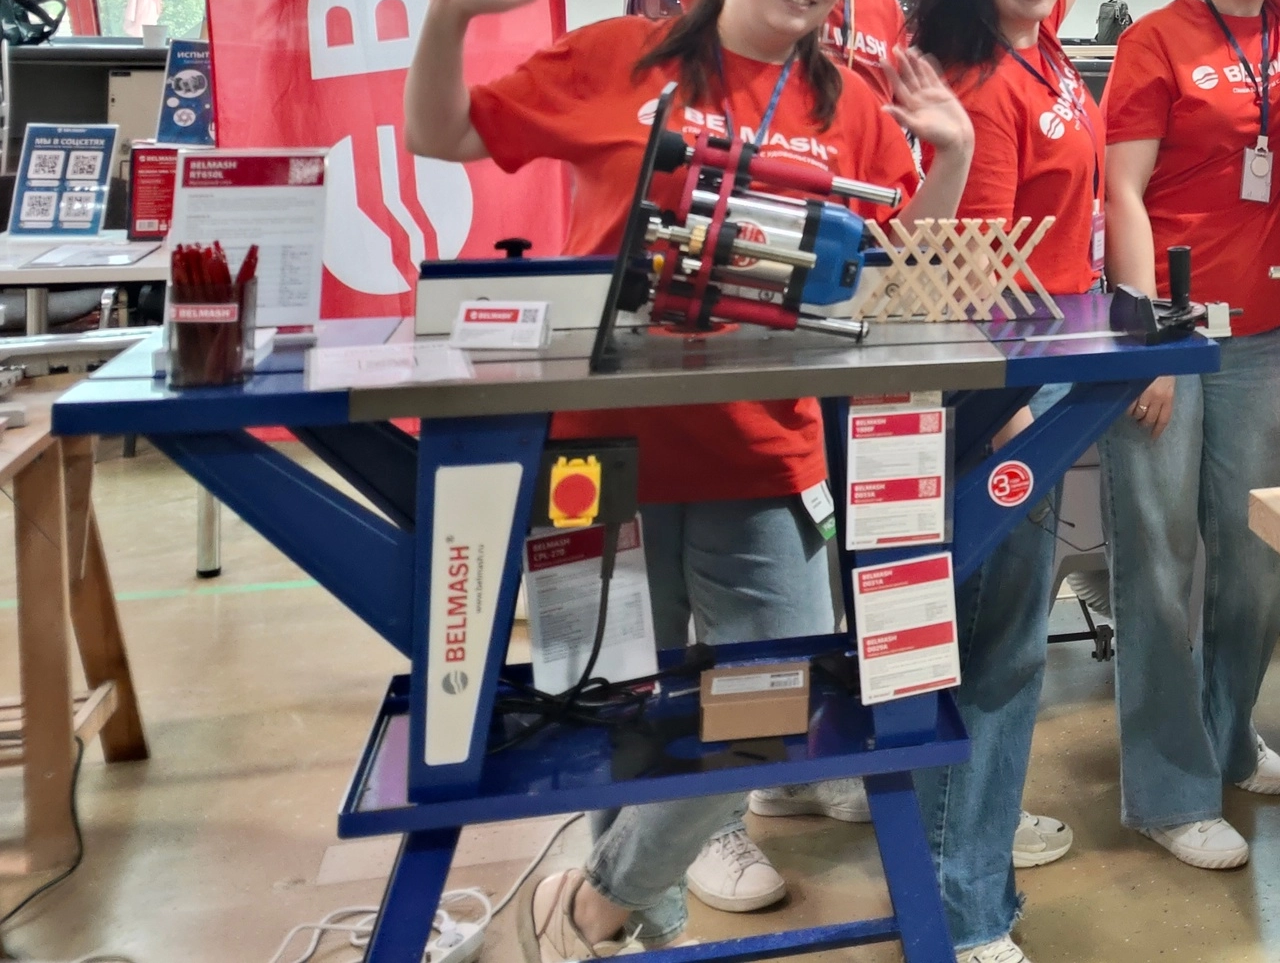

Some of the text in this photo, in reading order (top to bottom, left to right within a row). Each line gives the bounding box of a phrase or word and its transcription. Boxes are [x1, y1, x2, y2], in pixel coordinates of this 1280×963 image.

[819, 23, 887, 59] LMASH
[35, 137, 51, 145] МЫ
[60, 138, 105, 146] СОЦСЕТЯХ
[190, 161, 237, 169] BELMASH
[178, 309, 230, 318] BELMASH
[993, 474, 1010, 497] 3
[476, 545, 485, 614] www.belmash.ru
